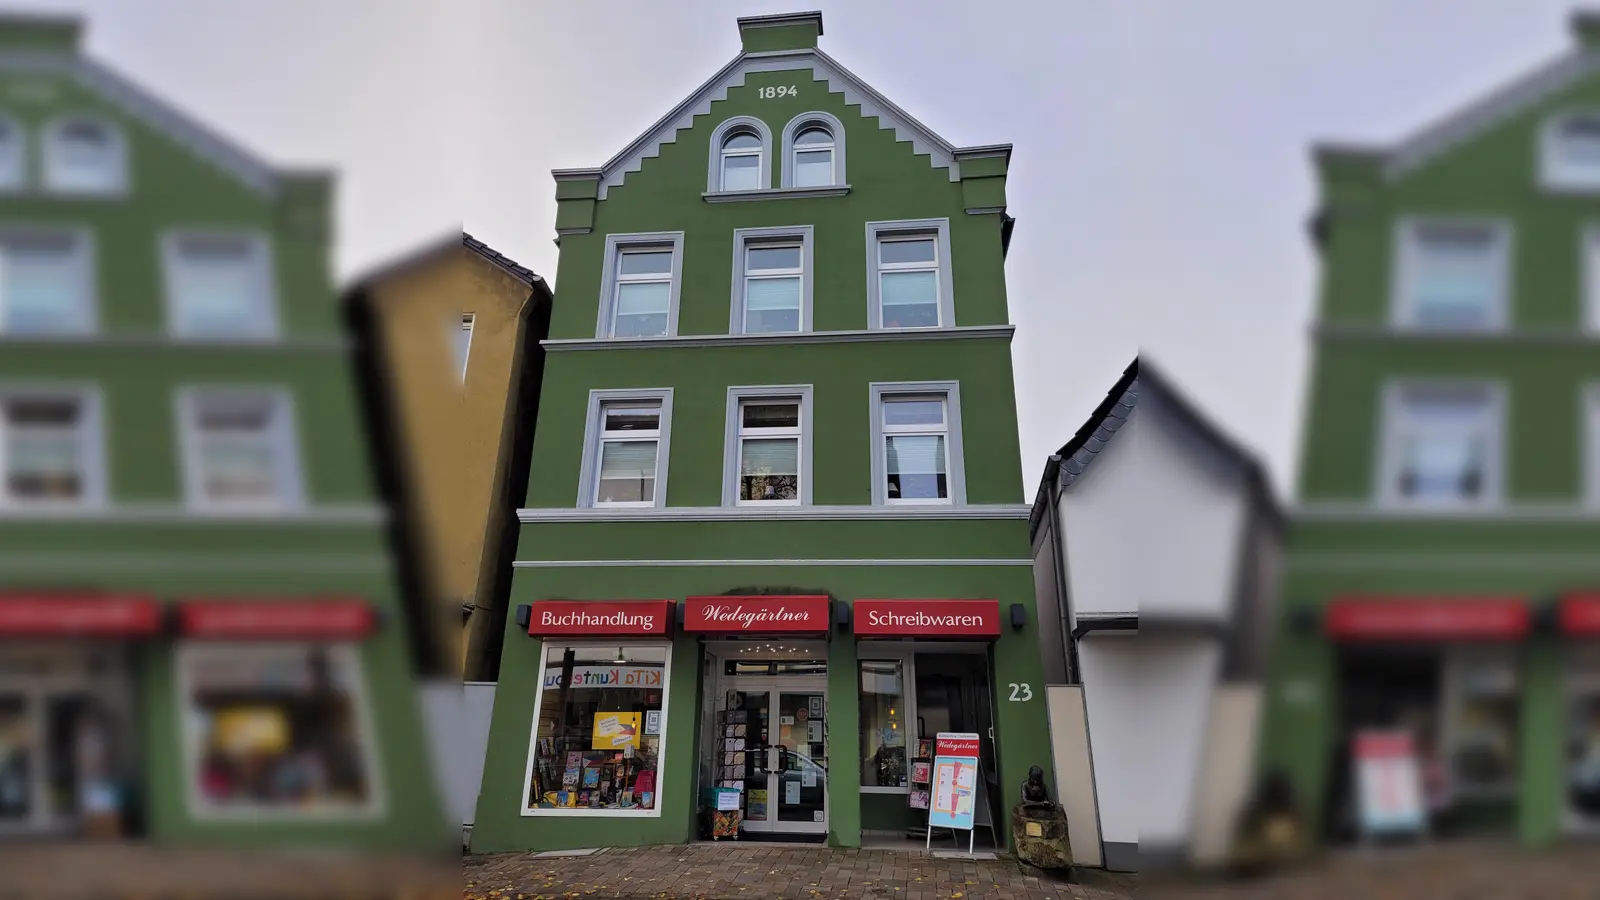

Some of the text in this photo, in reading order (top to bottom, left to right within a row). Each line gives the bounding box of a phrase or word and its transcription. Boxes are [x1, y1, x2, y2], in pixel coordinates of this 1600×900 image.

[758, 85, 797, 99] 1894
[541, 611, 653, 630] Buchhandlung
[701, 604, 810, 629] Wedegärtner
[868, 610, 983, 626] Schreibwaren
[1008, 683, 1033, 702] 23
